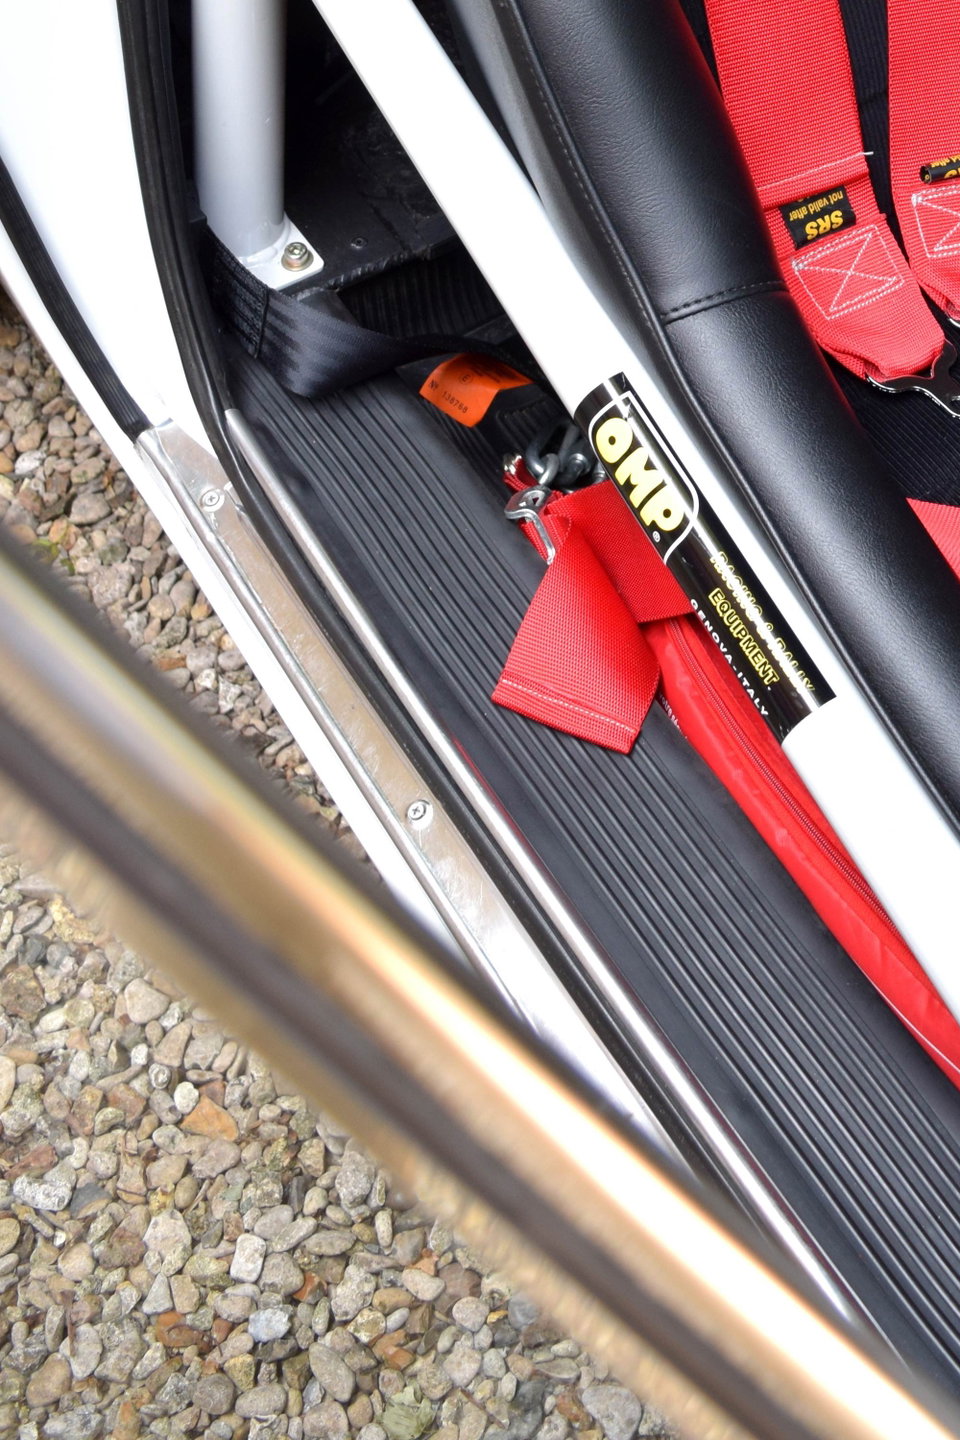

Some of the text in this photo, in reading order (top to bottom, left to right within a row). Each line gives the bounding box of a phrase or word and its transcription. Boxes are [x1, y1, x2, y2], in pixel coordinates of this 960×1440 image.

[789, 191, 844, 221] not valid after
[805, 210, 844, 240] SRS
[596, 417, 684, 531] OMP
[706, 586, 781, 687] EQUIPMENT
[709, 550, 764, 622] RACING
[766, 636, 815, 697] RALLY
